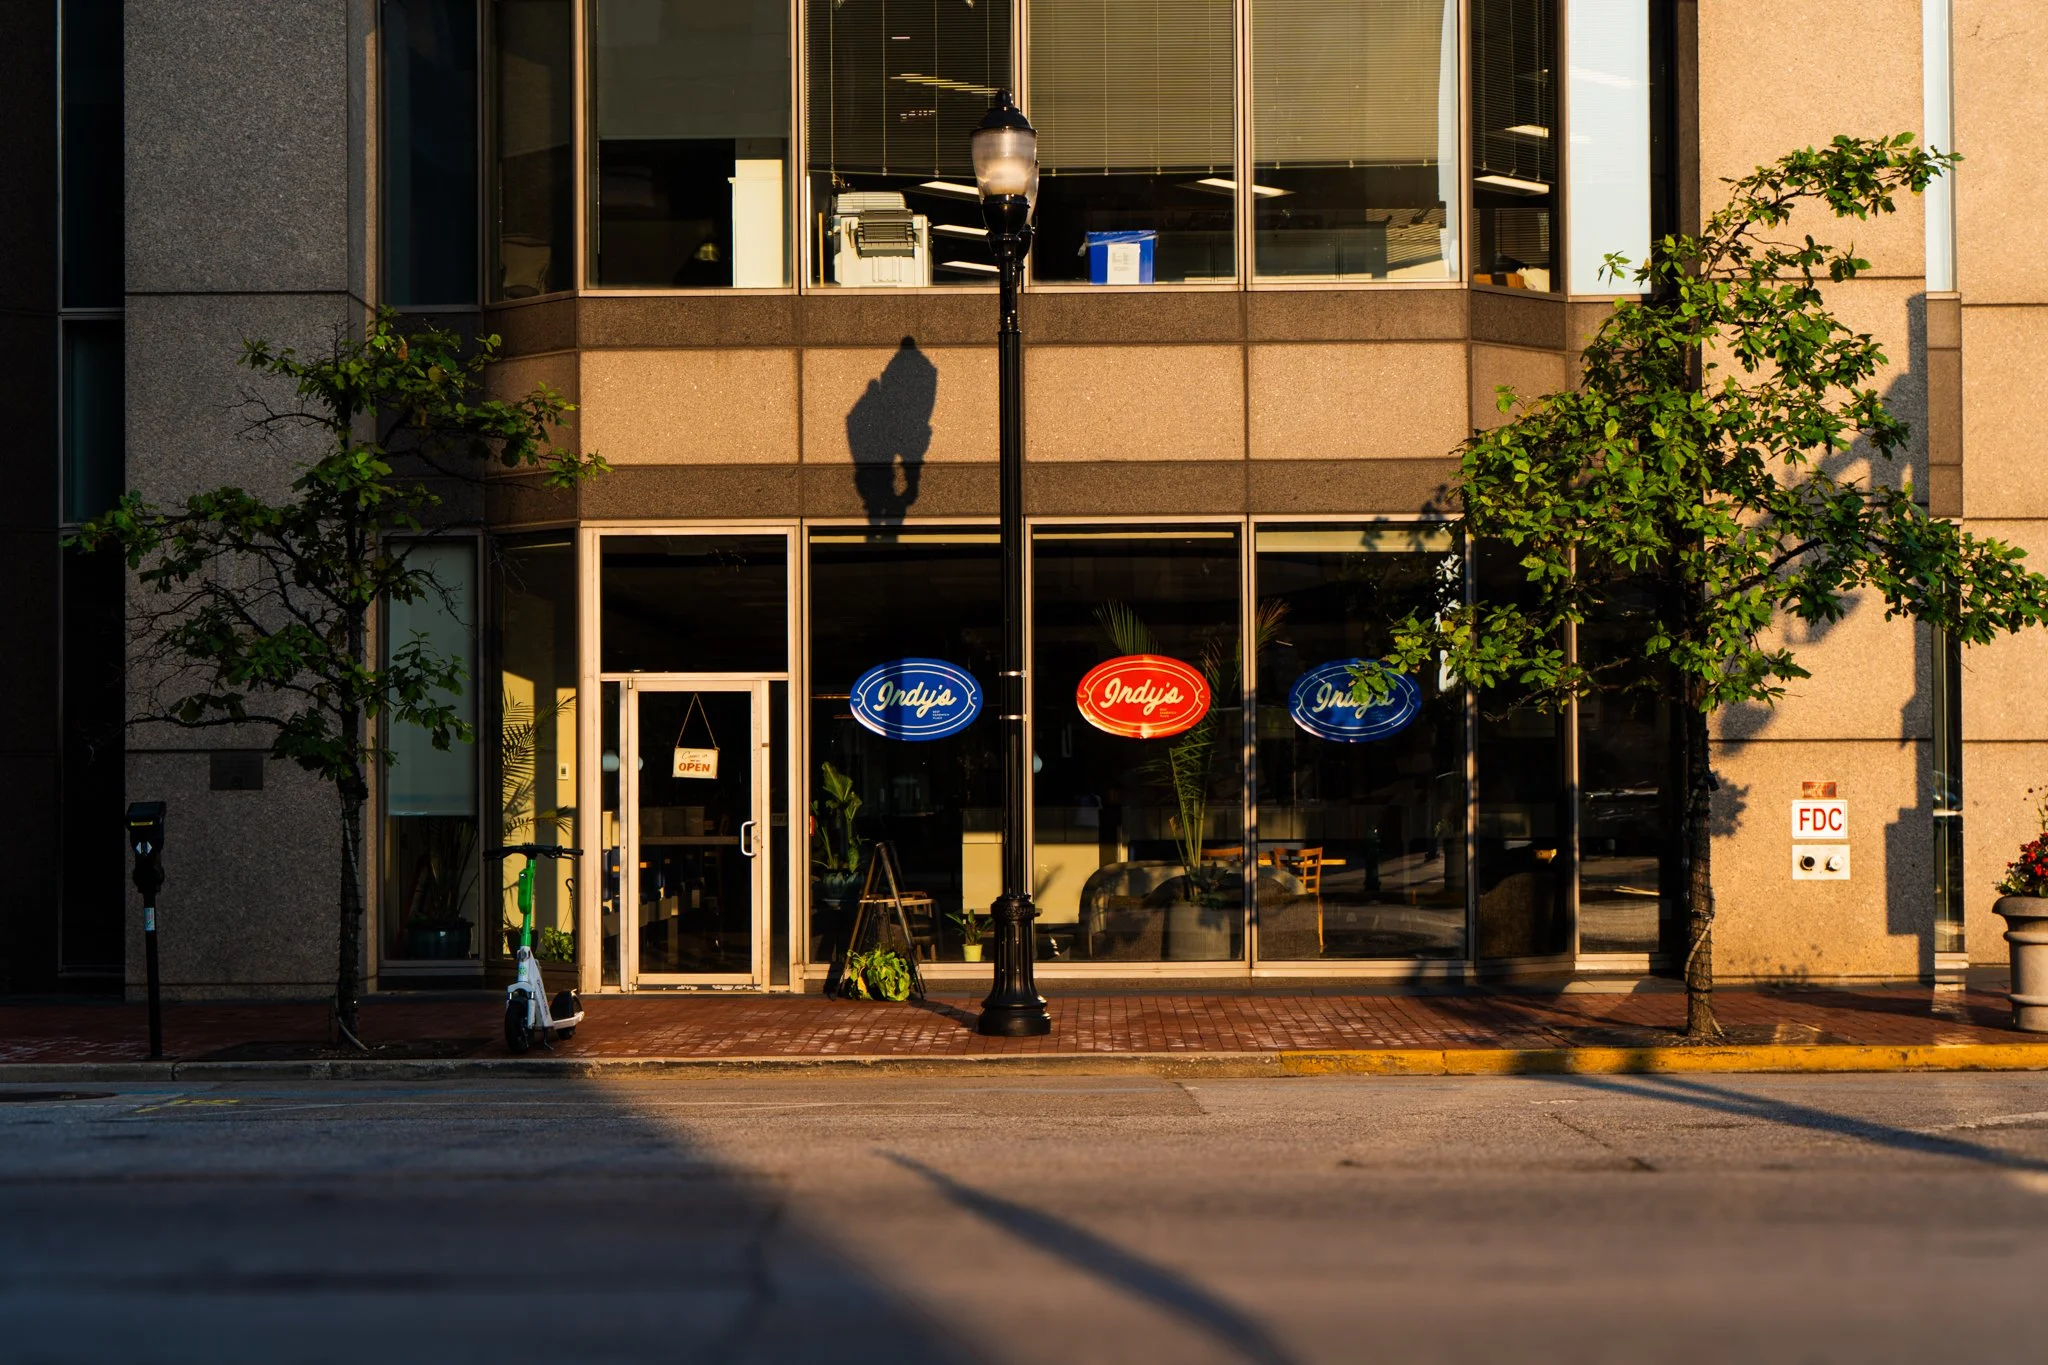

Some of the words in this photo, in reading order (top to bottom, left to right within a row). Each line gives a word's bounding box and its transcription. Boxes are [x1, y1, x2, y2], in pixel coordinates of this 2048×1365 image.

[873, 680, 957, 718] Indy's
[1099, 677, 1184, 716] Indy's
[679, 762, 711, 772] OPEN
[1799, 808, 1842, 831] FDC
